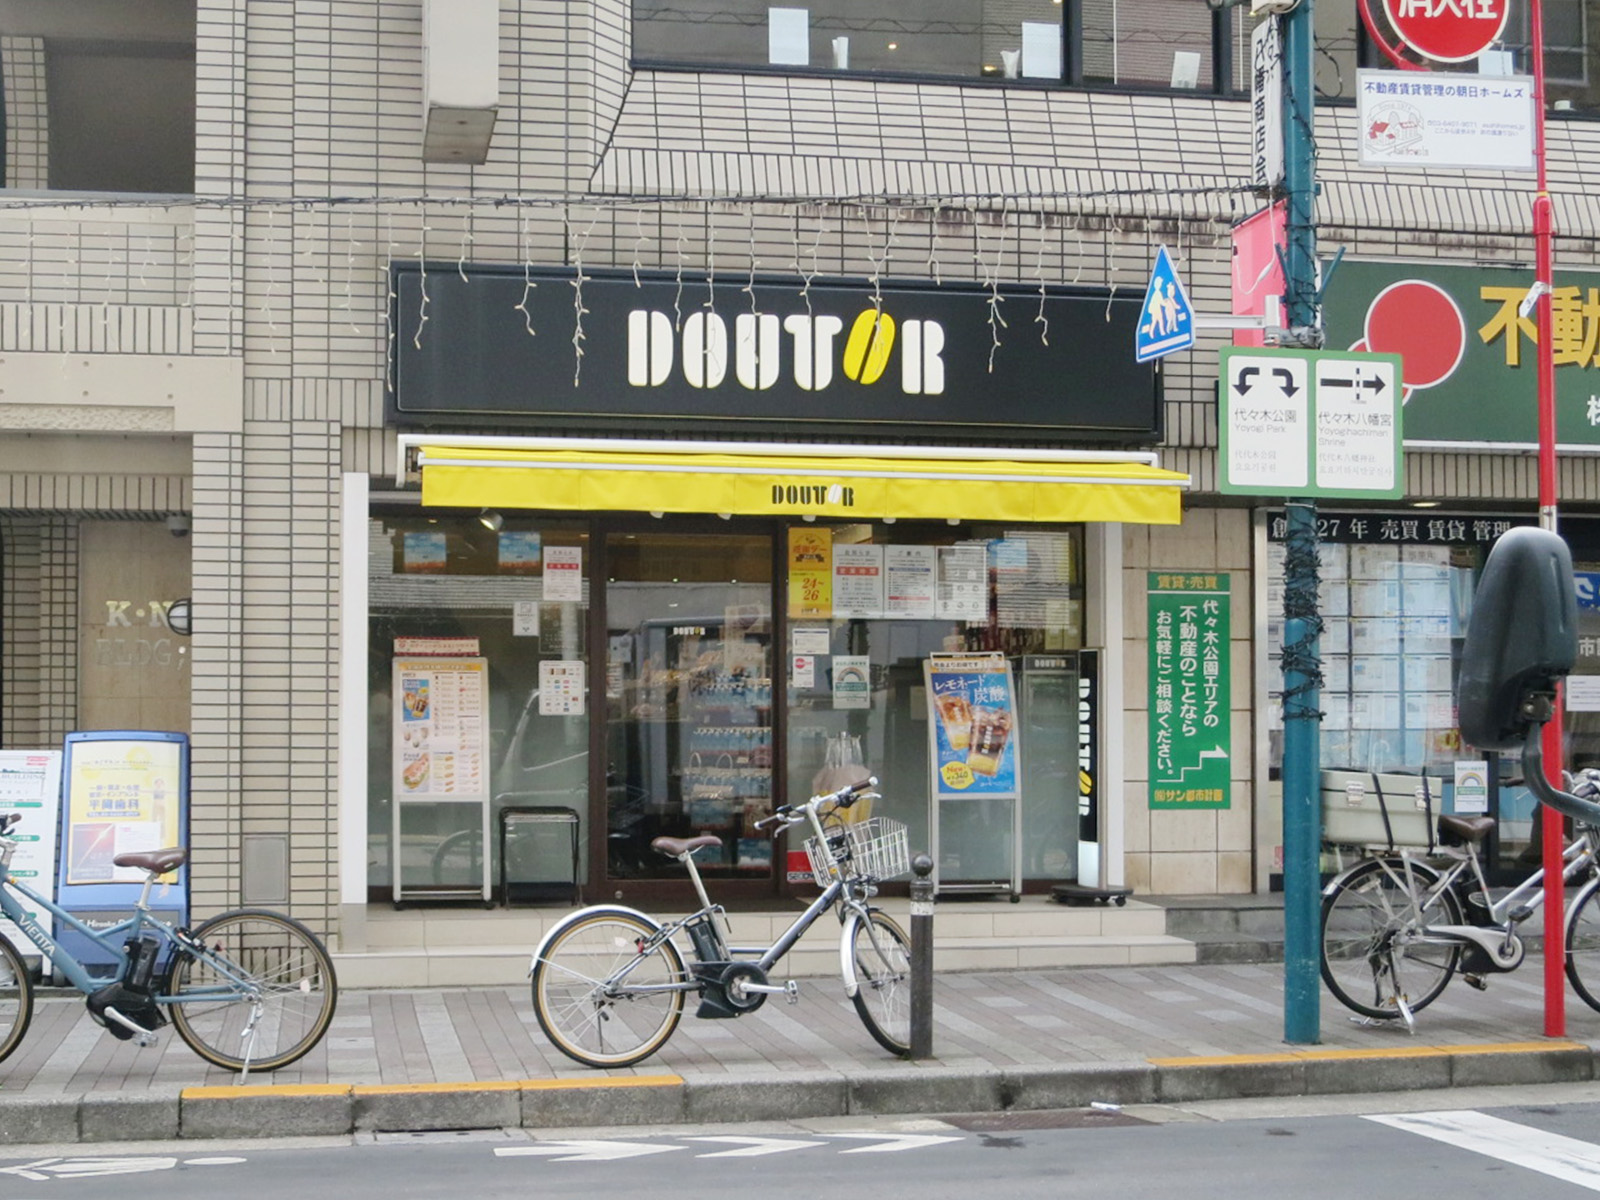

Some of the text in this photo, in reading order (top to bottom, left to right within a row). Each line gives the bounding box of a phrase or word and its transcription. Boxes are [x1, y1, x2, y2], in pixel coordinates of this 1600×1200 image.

[1364, 81, 1524, 98] 不動産賃貸管理の朝日ホームズ
[628, 309, 945, 395] DOUTOR
[1234, 409, 1297, 423] 代々木公園
[1318, 412, 1392, 427] 代々木八幡宮
[1235, 424, 1287, 434] Yoyogi Park
[1318, 437, 1346, 447] Shrine
[772, 484, 854, 506] DOUTOR
[1350, 519, 1368, 539] 年
[1380, 520, 1419, 540] 売買
[1428, 520, 1464, 541] 賃貸
[1158, 576, 1217, 589] 賃貸・売買
[803, 590, 820, 601] 26
[1180, 605, 1197, 737] 不動産のことなら
[1203, 600, 1219, 728] 代々木公園エリアの
[935, 675, 986, 692] レモネード
[1156, 610, 1174, 775] お気軽にご相談ください。
